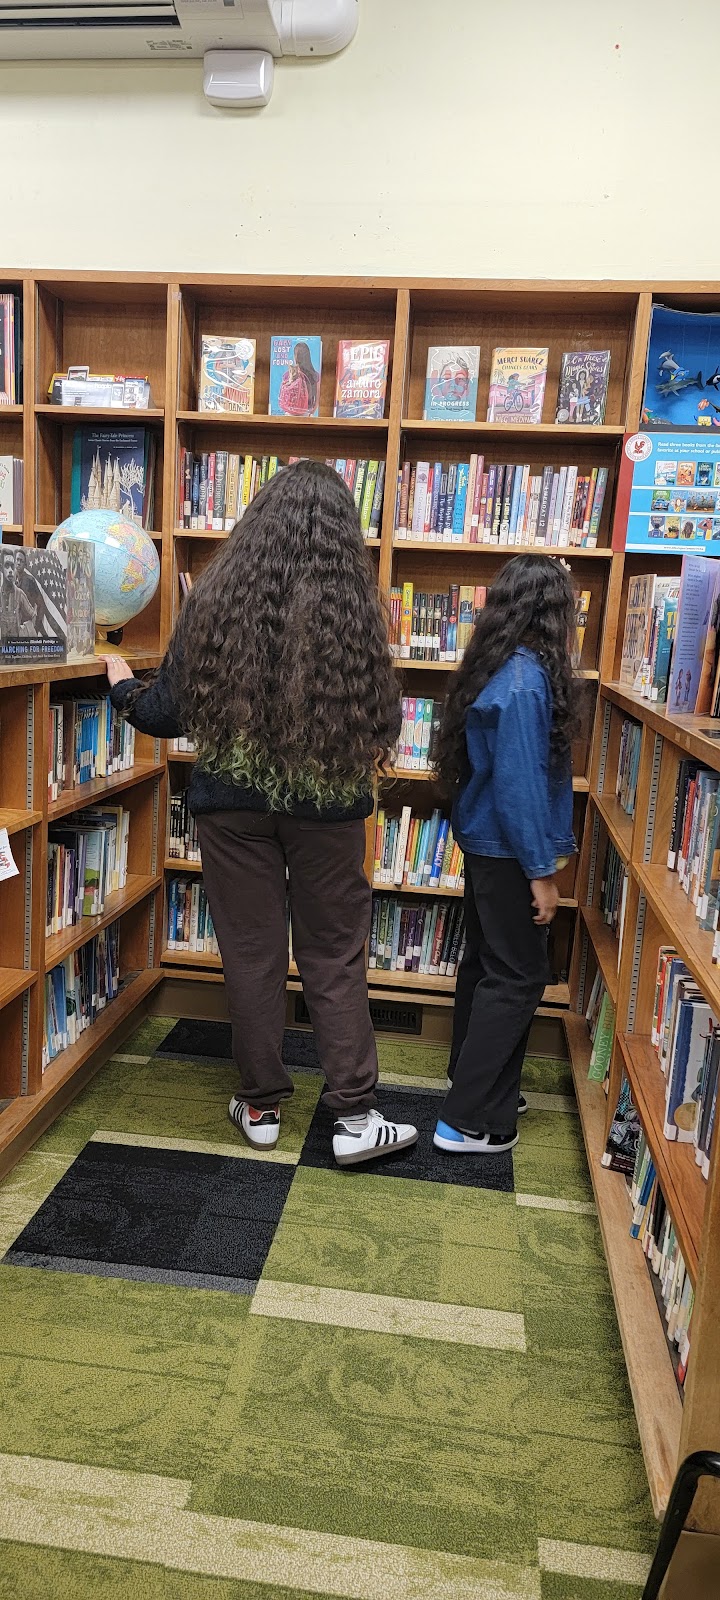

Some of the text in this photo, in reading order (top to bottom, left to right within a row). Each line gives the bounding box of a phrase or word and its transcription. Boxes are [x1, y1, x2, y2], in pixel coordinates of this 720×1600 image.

[350, 345, 383, 361] EPIC
[497, 356, 518, 365] MERCI
[341, 389, 381, 399] zamora
[1, 645, 64, 653] MARCHING FOR FREEDOM
